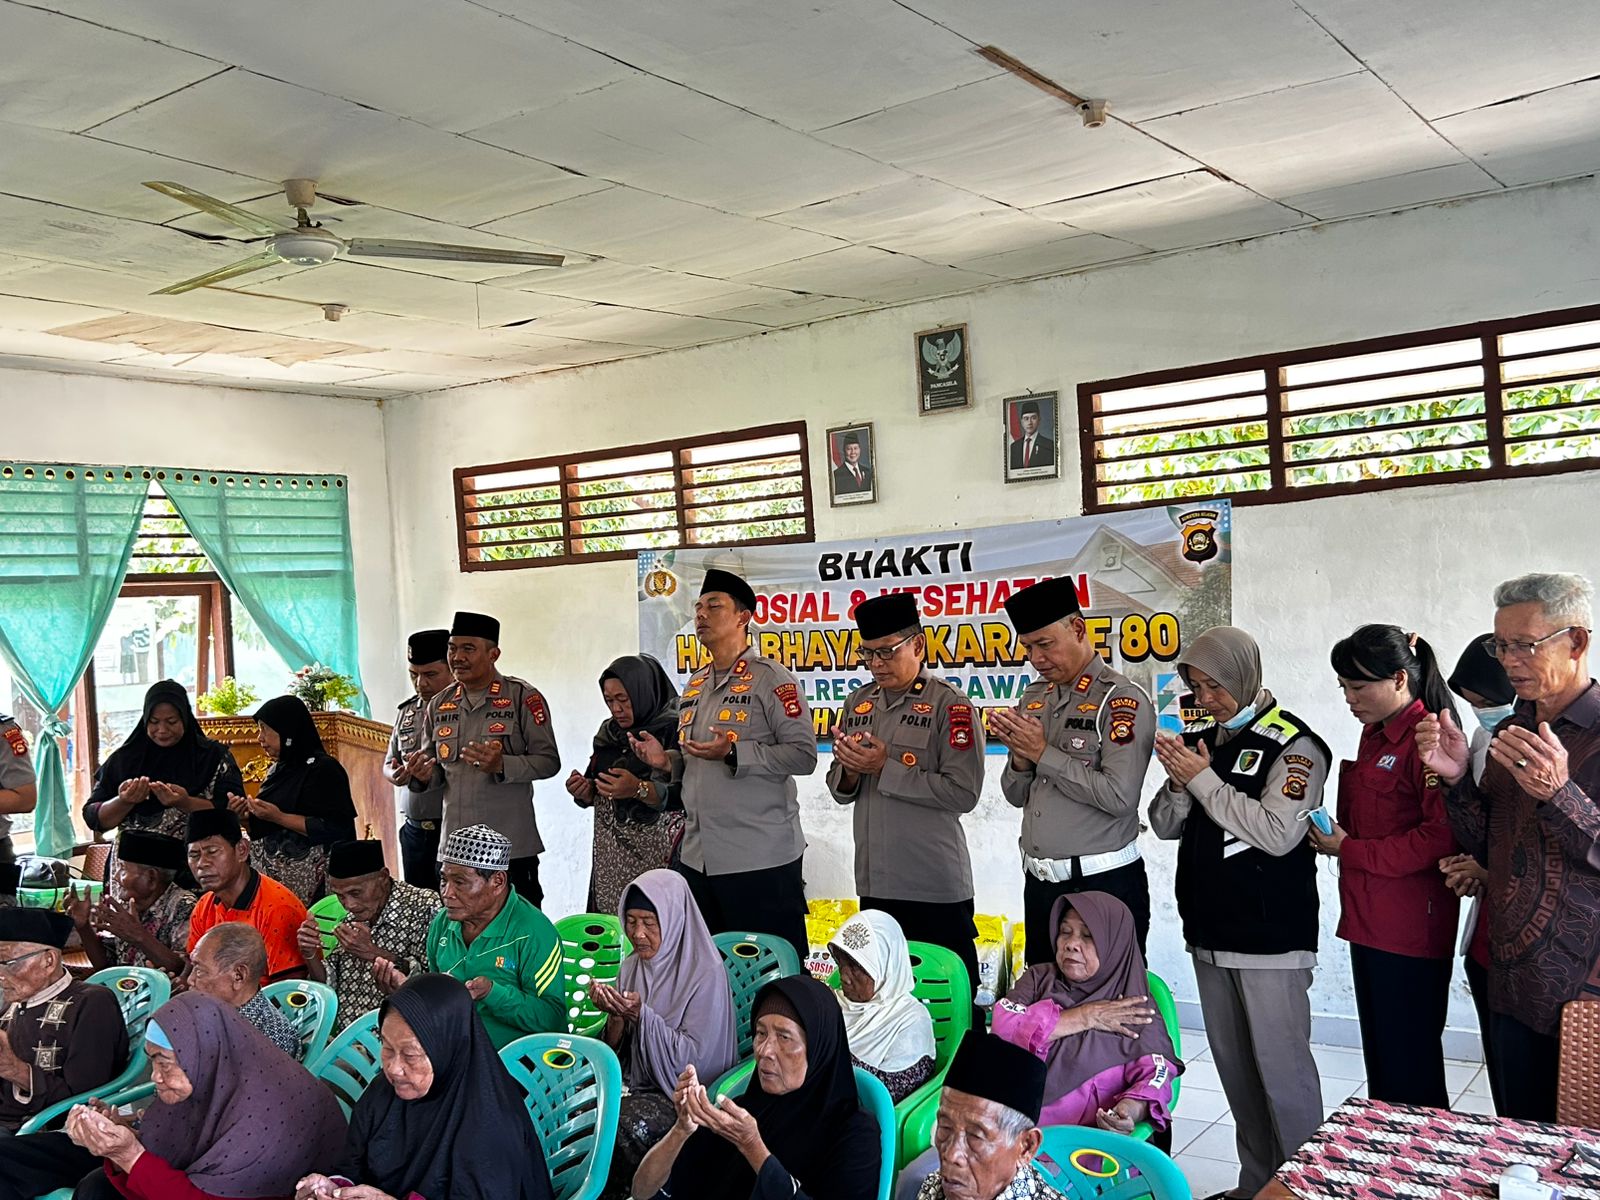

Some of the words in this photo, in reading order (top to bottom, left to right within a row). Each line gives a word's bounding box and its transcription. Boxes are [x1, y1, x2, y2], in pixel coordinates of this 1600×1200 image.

[818, 541, 973, 582] BHAKTI
[753, 591, 840, 625] OSIAL
[1120, 611, 1181, 663] 80
[722, 695, 752, 705] POLRI
[436, 713, 460, 724] AMIR
[485, 711, 515, 720] POLRI
[847, 715, 873, 728] RUDI
[900, 714, 932, 729] POLRI
